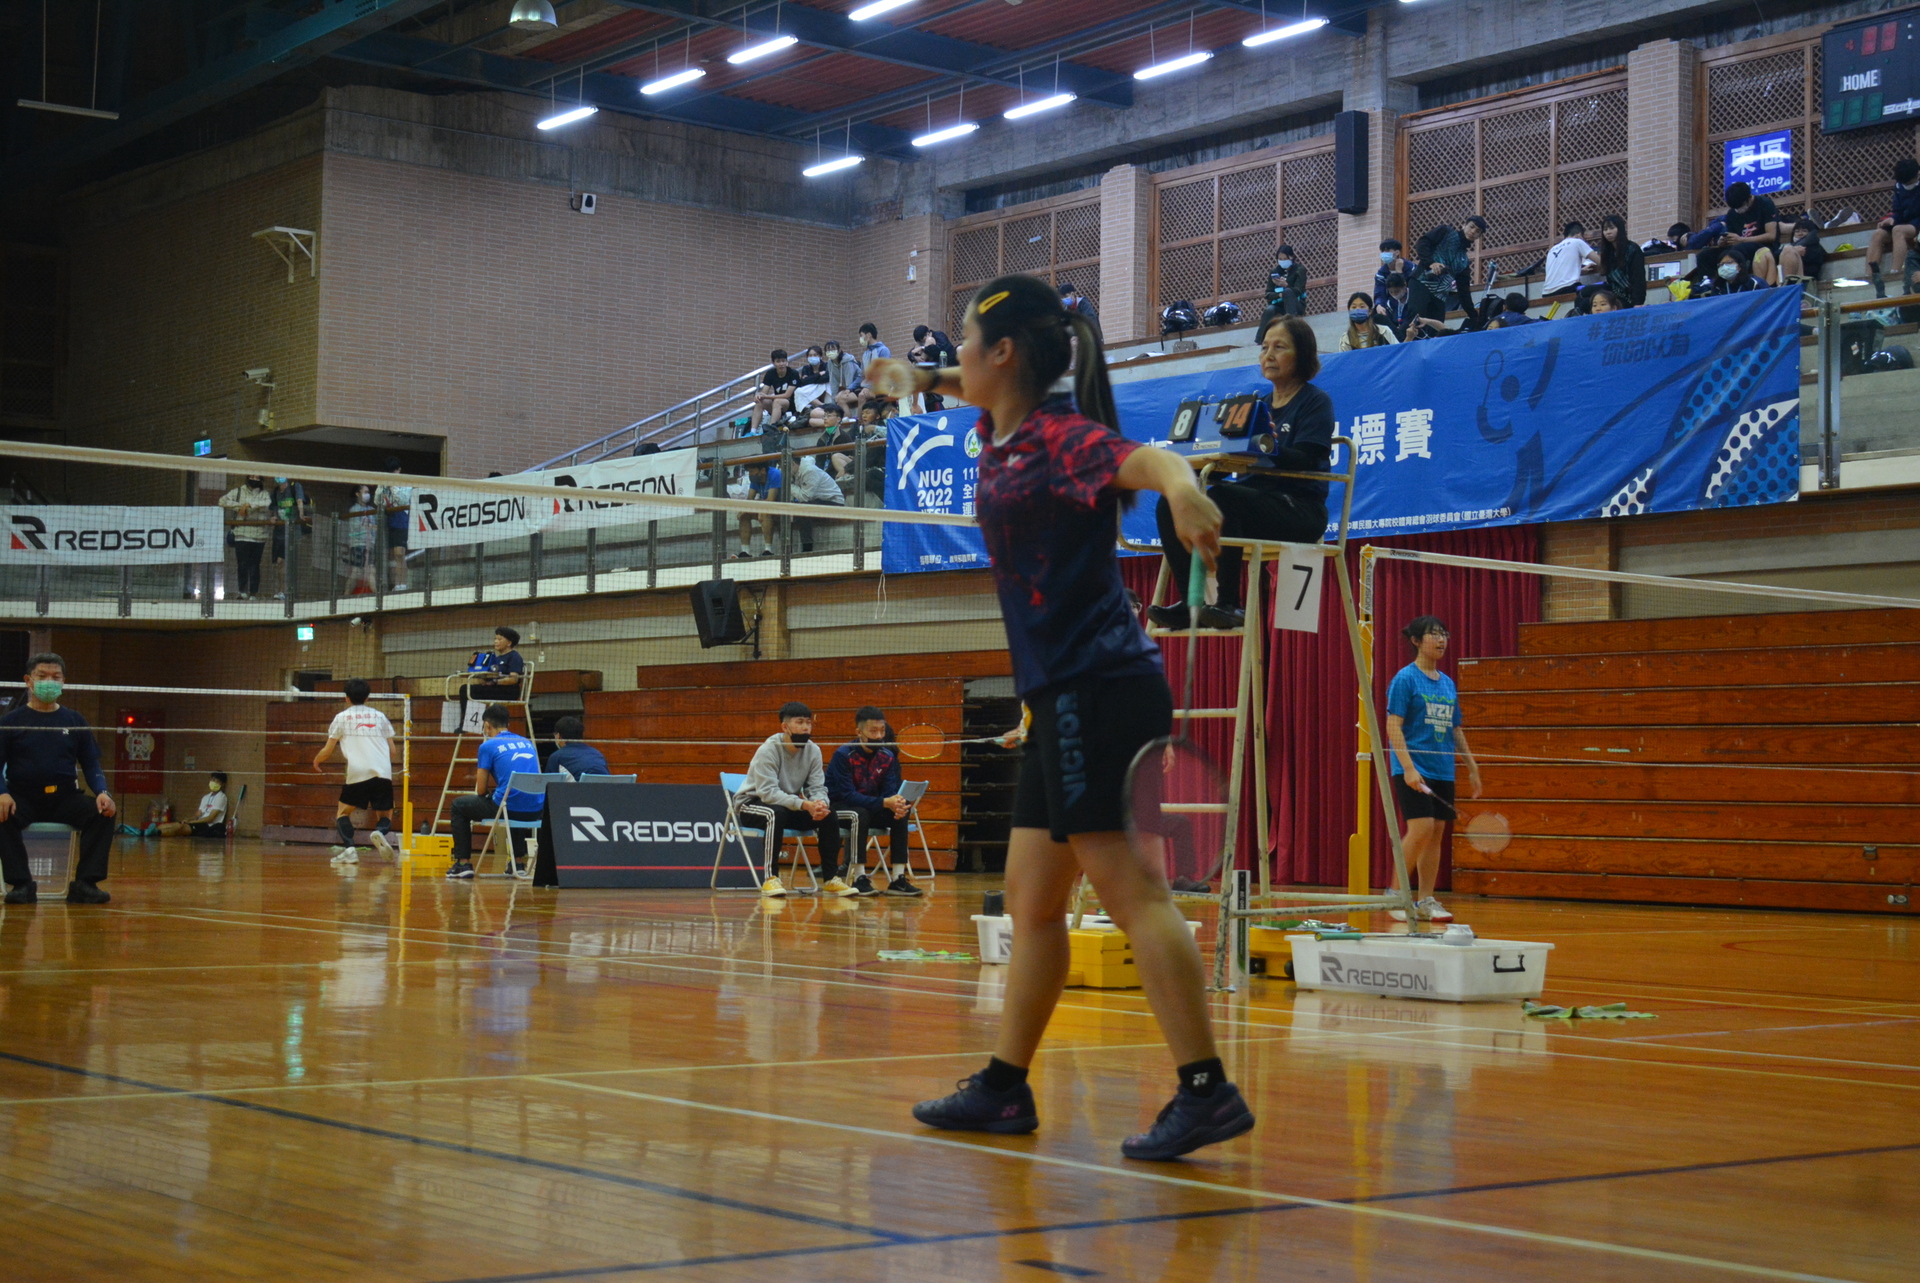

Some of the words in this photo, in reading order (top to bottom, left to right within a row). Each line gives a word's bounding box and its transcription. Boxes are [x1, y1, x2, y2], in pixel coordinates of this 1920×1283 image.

[1842, 69, 1879, 92] HOME
[1730, 137, 1786, 176] 東區
[1757, 176, 1783, 188] Zone
[1174, 409, 1192, 436] 8
[1224, 402, 1252, 429] 14
[1329, 408, 1433, 466] 標賽
[918, 468, 953, 488] NUG
[917, 488, 952, 507] 2022
[441, 496, 525, 529] REDSON
[55, 527, 194, 550] REDSON
[1292, 564, 1313, 611] 7
[470, 711, 479, 726] 4
[1056, 690, 1087, 809] VICTOR
[612, 821, 736, 843] REDSON
[1347, 968, 1428, 991] REDSON
